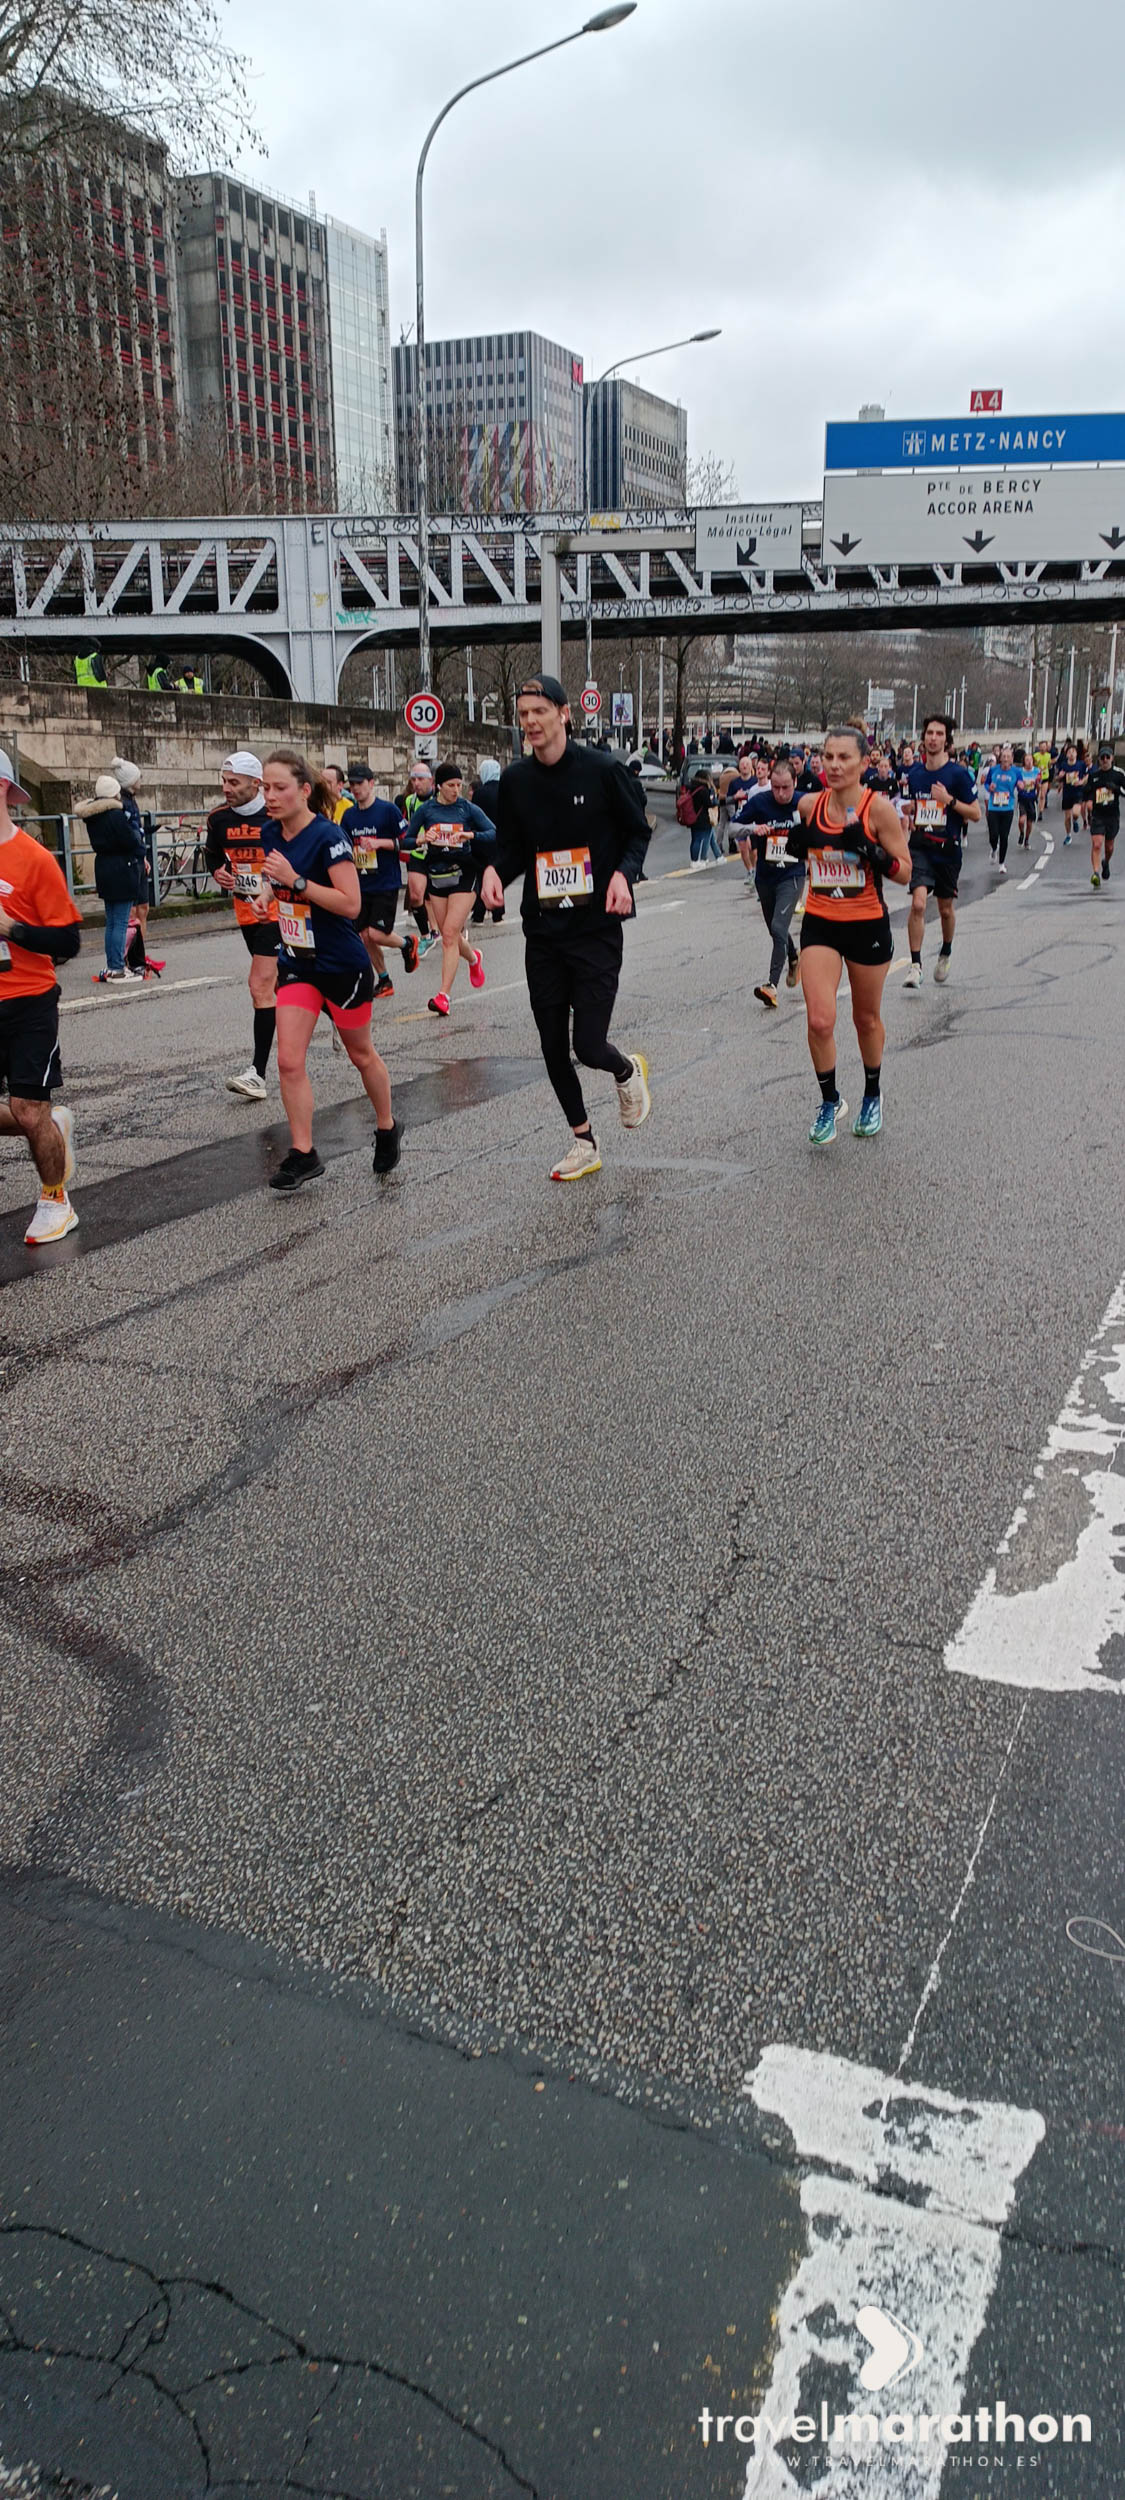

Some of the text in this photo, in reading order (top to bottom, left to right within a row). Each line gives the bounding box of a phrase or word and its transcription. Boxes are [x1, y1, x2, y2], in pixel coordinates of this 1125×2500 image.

[931, 429, 1067, 452] METZ-NANCY
[984, 479, 1042, 494] BERCY
[927, 500, 1034, 516] ACCOR ARENA
[625, 509, 667, 526] ASUM
[725, 512, 773, 525] Institut
[586, 695, 598, 706] 30
[414, 706, 436, 722] 30
[544, 866, 577, 887] 20327
